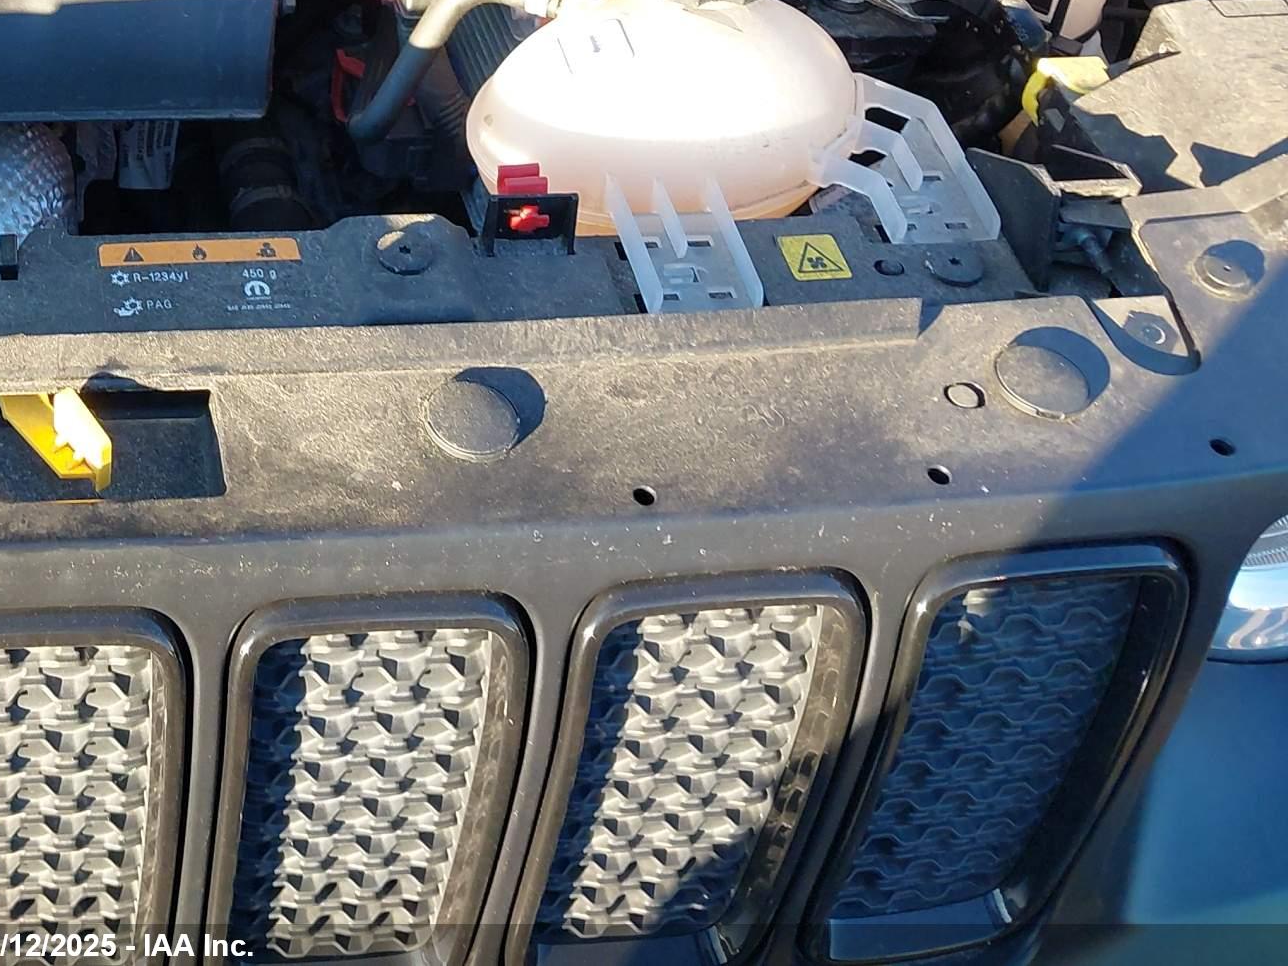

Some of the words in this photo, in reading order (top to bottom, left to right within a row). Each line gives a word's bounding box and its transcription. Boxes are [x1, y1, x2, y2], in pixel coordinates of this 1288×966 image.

[133, 270, 190, 283] R-1234yf
[242, 267, 264, 278] 450
[146, 299, 173, 310] PAG
